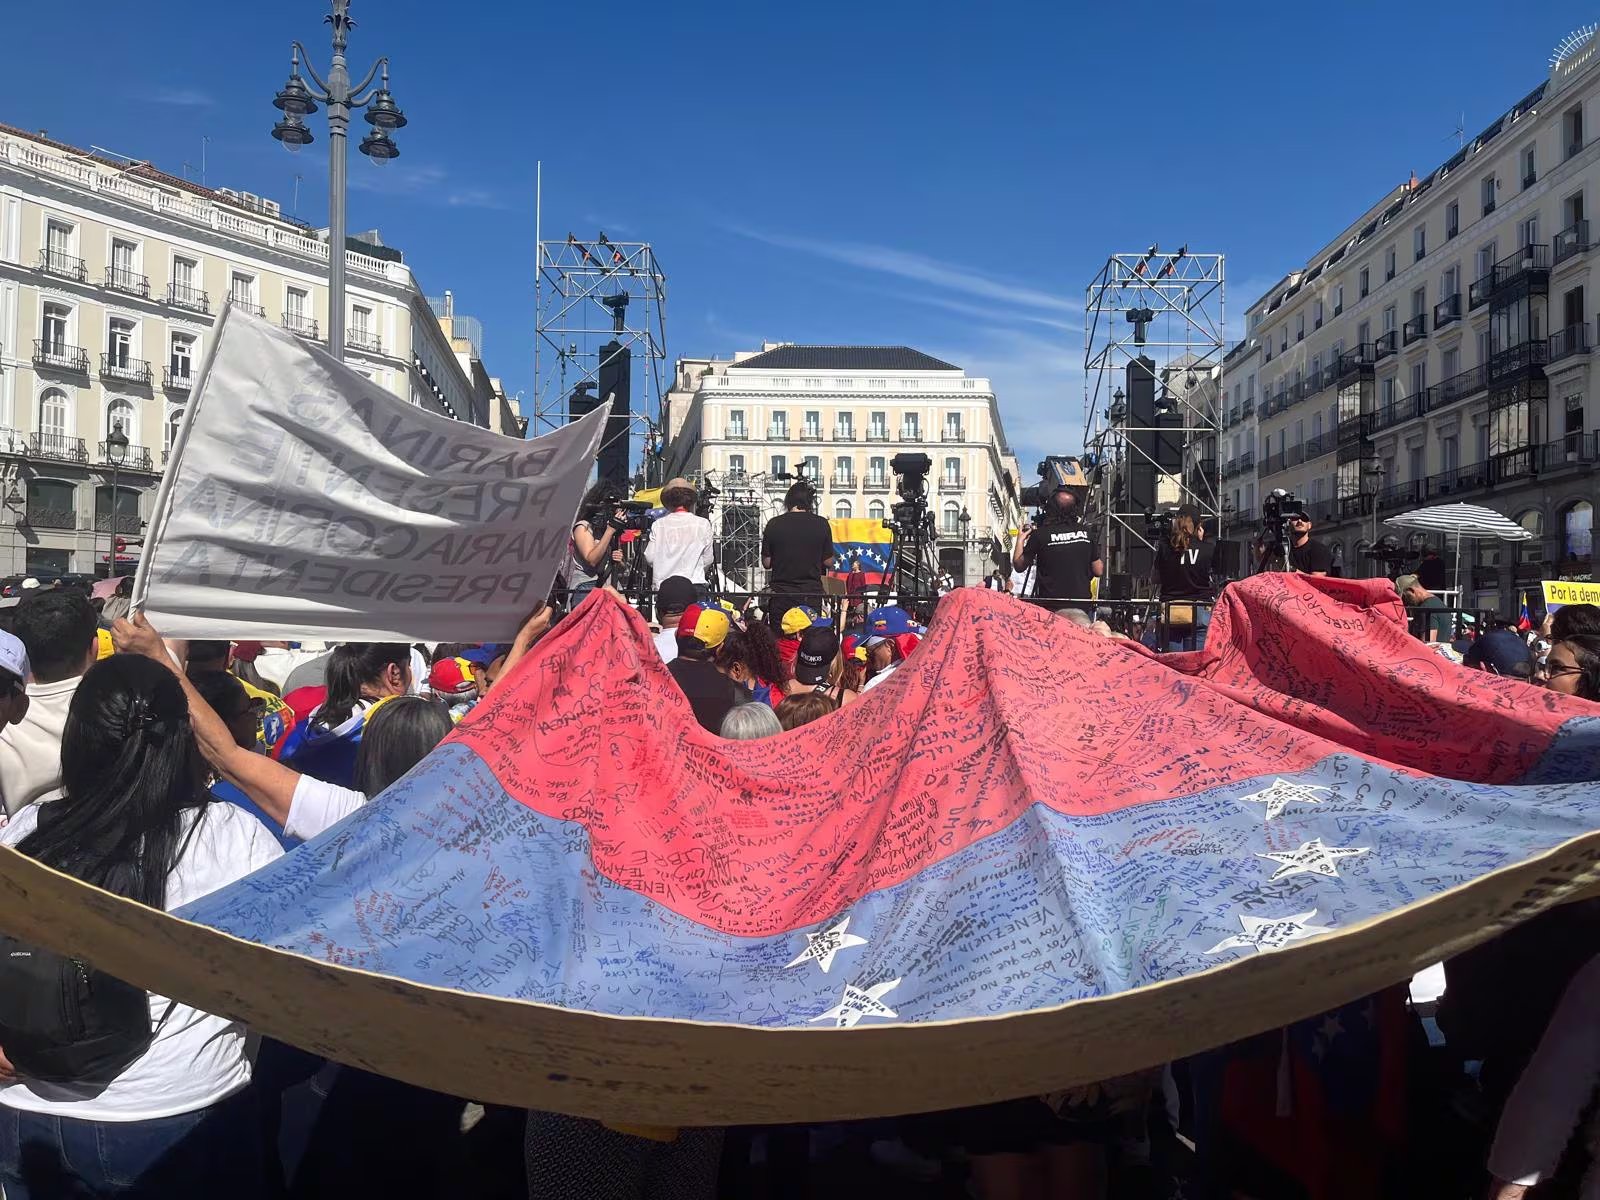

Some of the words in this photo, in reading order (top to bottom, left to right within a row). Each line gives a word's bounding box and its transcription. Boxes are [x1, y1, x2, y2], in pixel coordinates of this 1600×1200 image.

[1550, 585, 1567, 600] Por
[1569, 586, 1578, 602] la
[1580, 587, 1600, 603] dem
